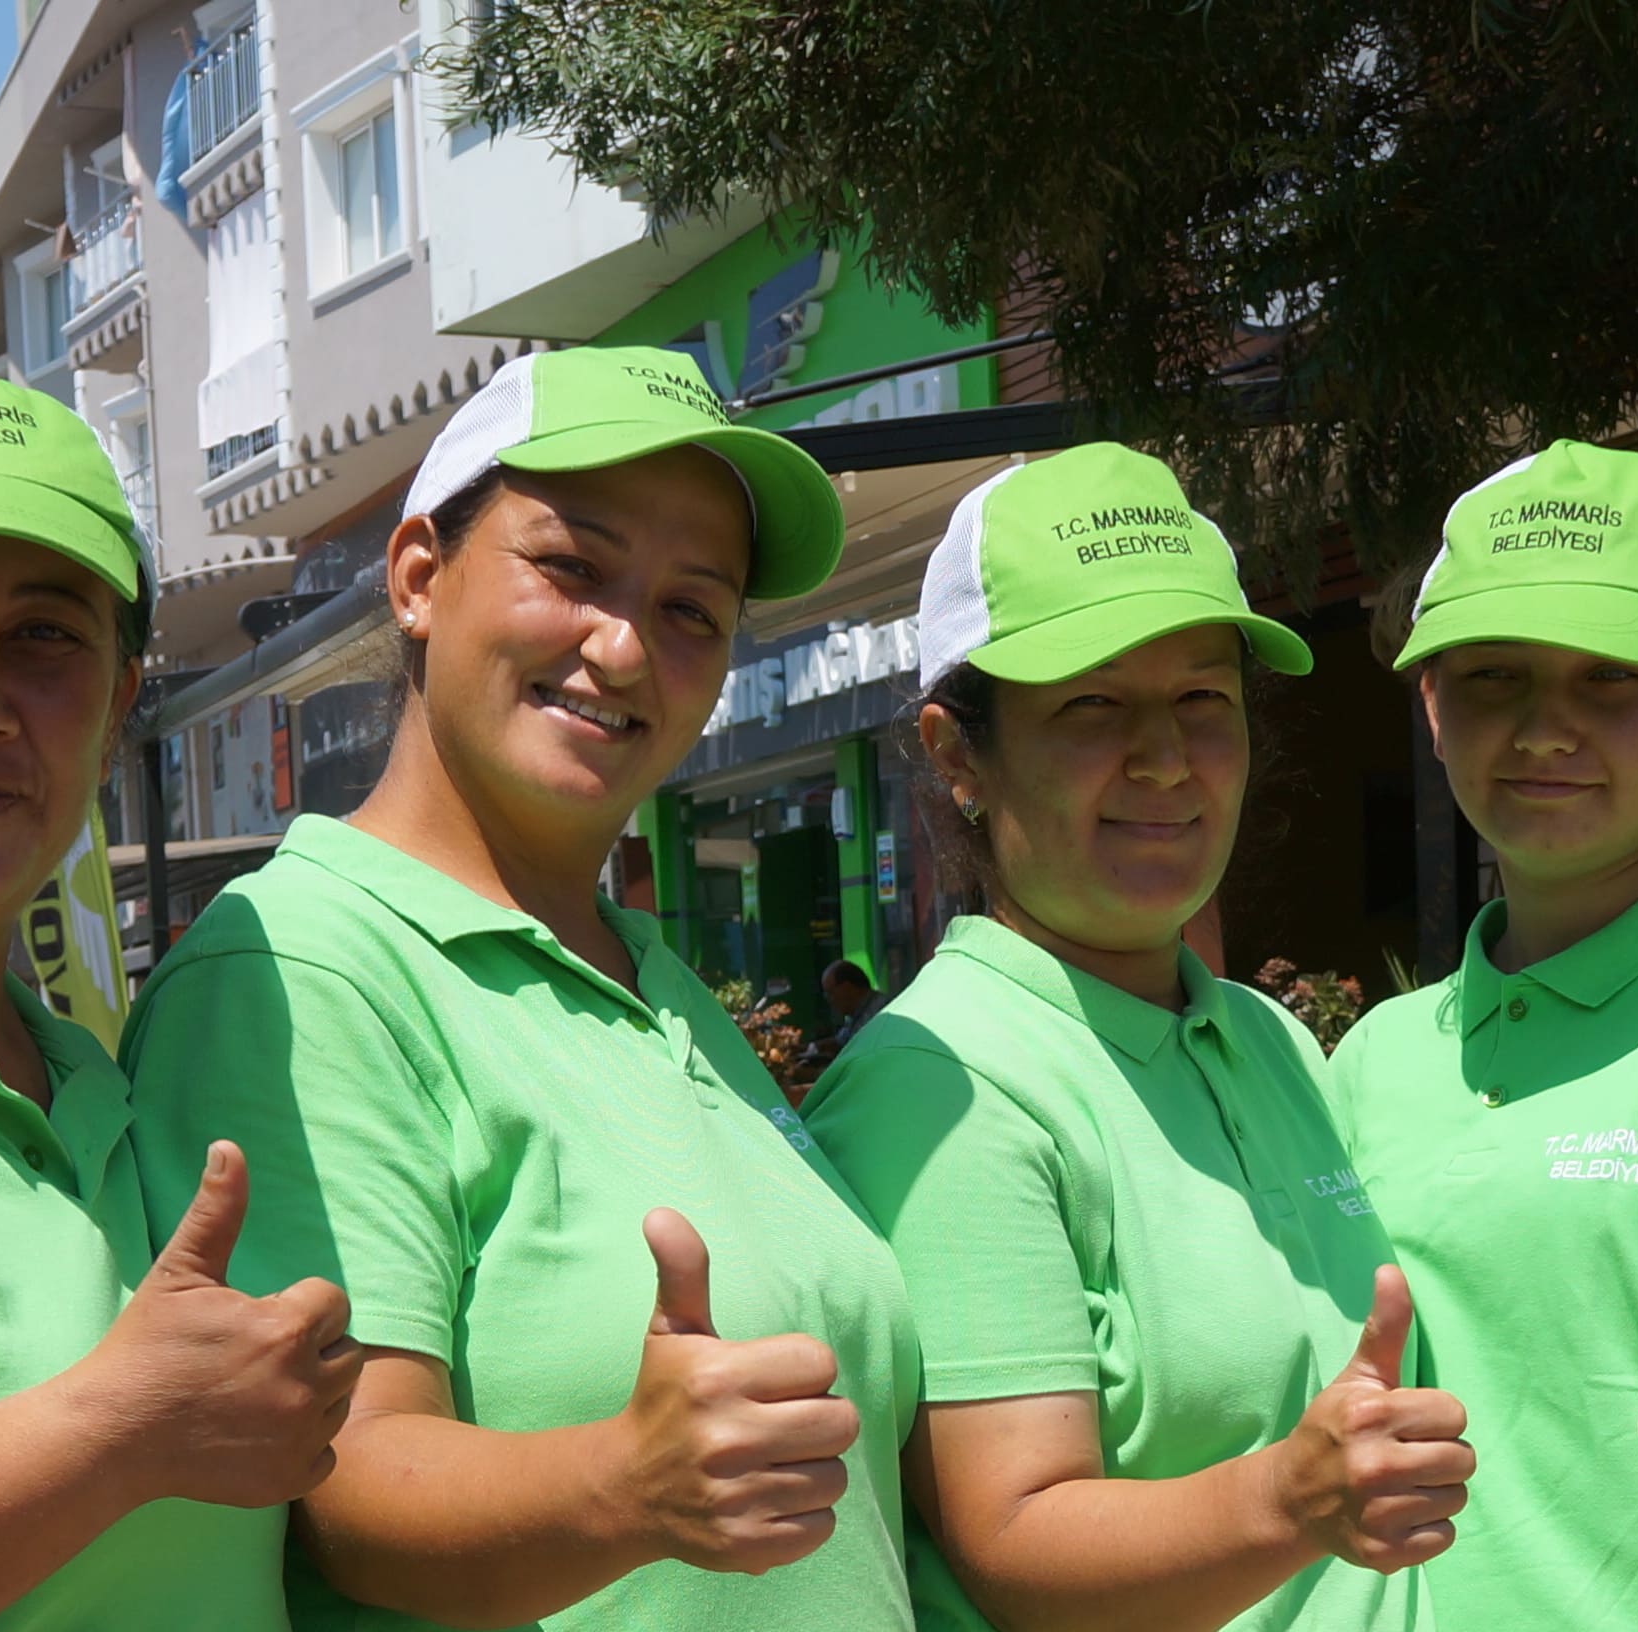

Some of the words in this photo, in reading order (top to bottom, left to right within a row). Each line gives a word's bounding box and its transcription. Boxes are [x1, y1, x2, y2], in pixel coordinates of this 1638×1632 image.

[1051, 518, 1090, 541] T.C.
[1091, 505, 1192, 530] MARMARİS
[1489, 508, 1514, 529] T.C.
[1518, 501, 1623, 527] MARMARİS
[1077, 531, 1192, 565] BELEDİYESİ
[1491, 525, 1603, 554] BELEDİYESİ
[1546, 1134, 1579, 1156] T.C.
